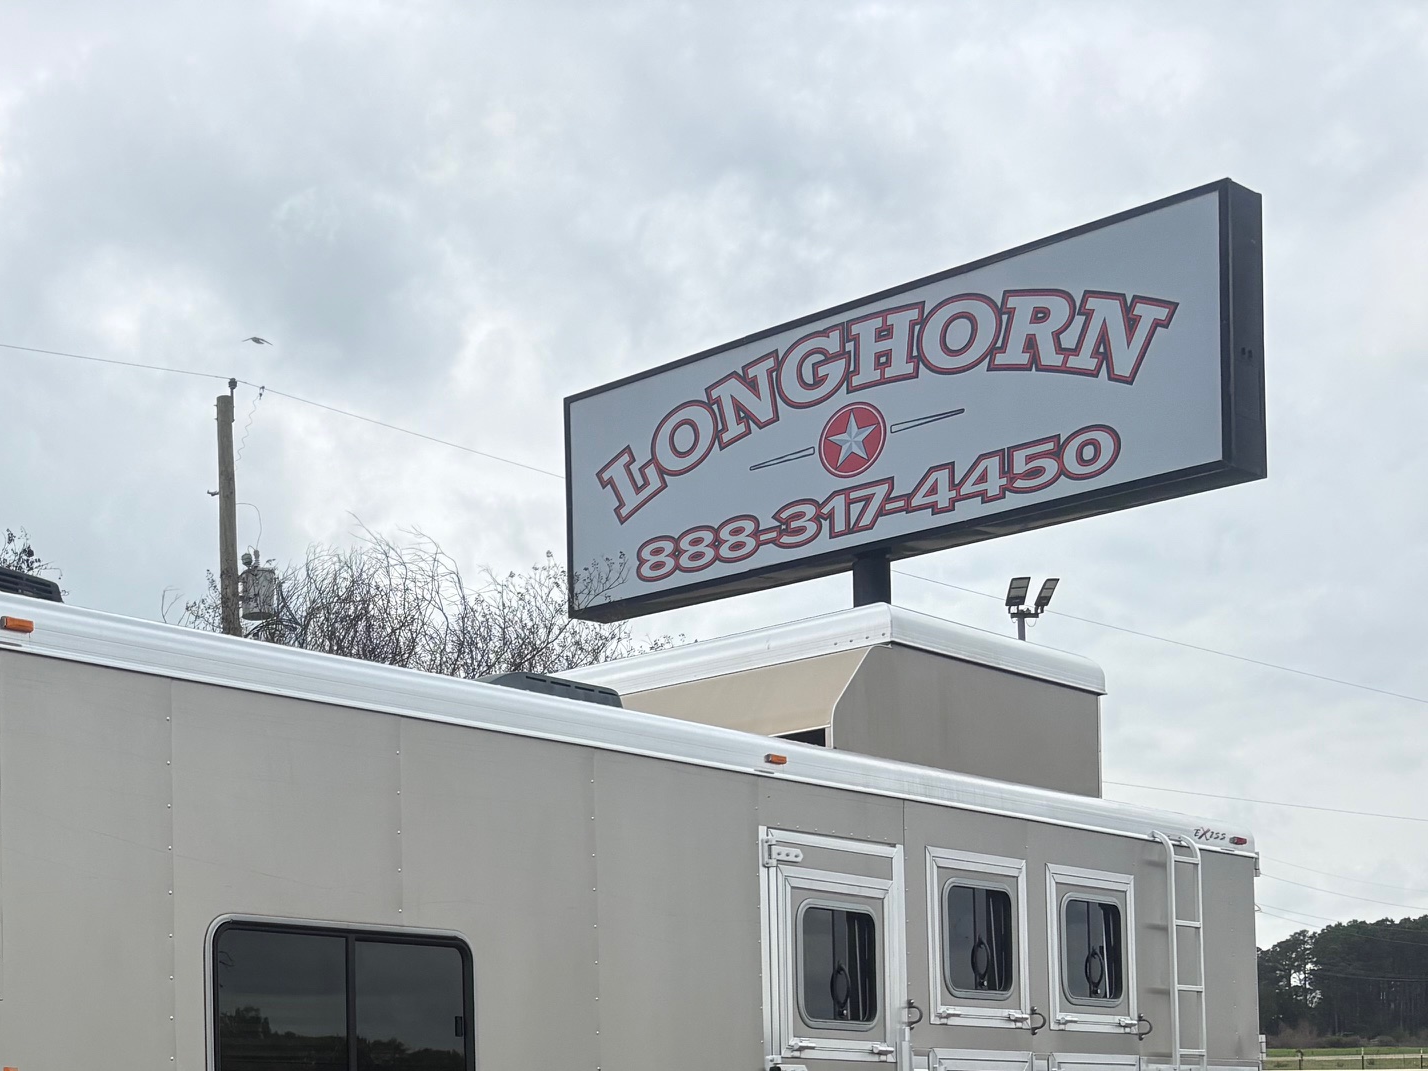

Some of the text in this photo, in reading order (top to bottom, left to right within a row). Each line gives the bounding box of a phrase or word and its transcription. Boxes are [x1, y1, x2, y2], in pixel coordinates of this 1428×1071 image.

[596, 288, 1180, 525] LONGHORN
[635, 423, 1121, 582] 888-317-4450
[1193, 827, 1226, 841] EXISS
